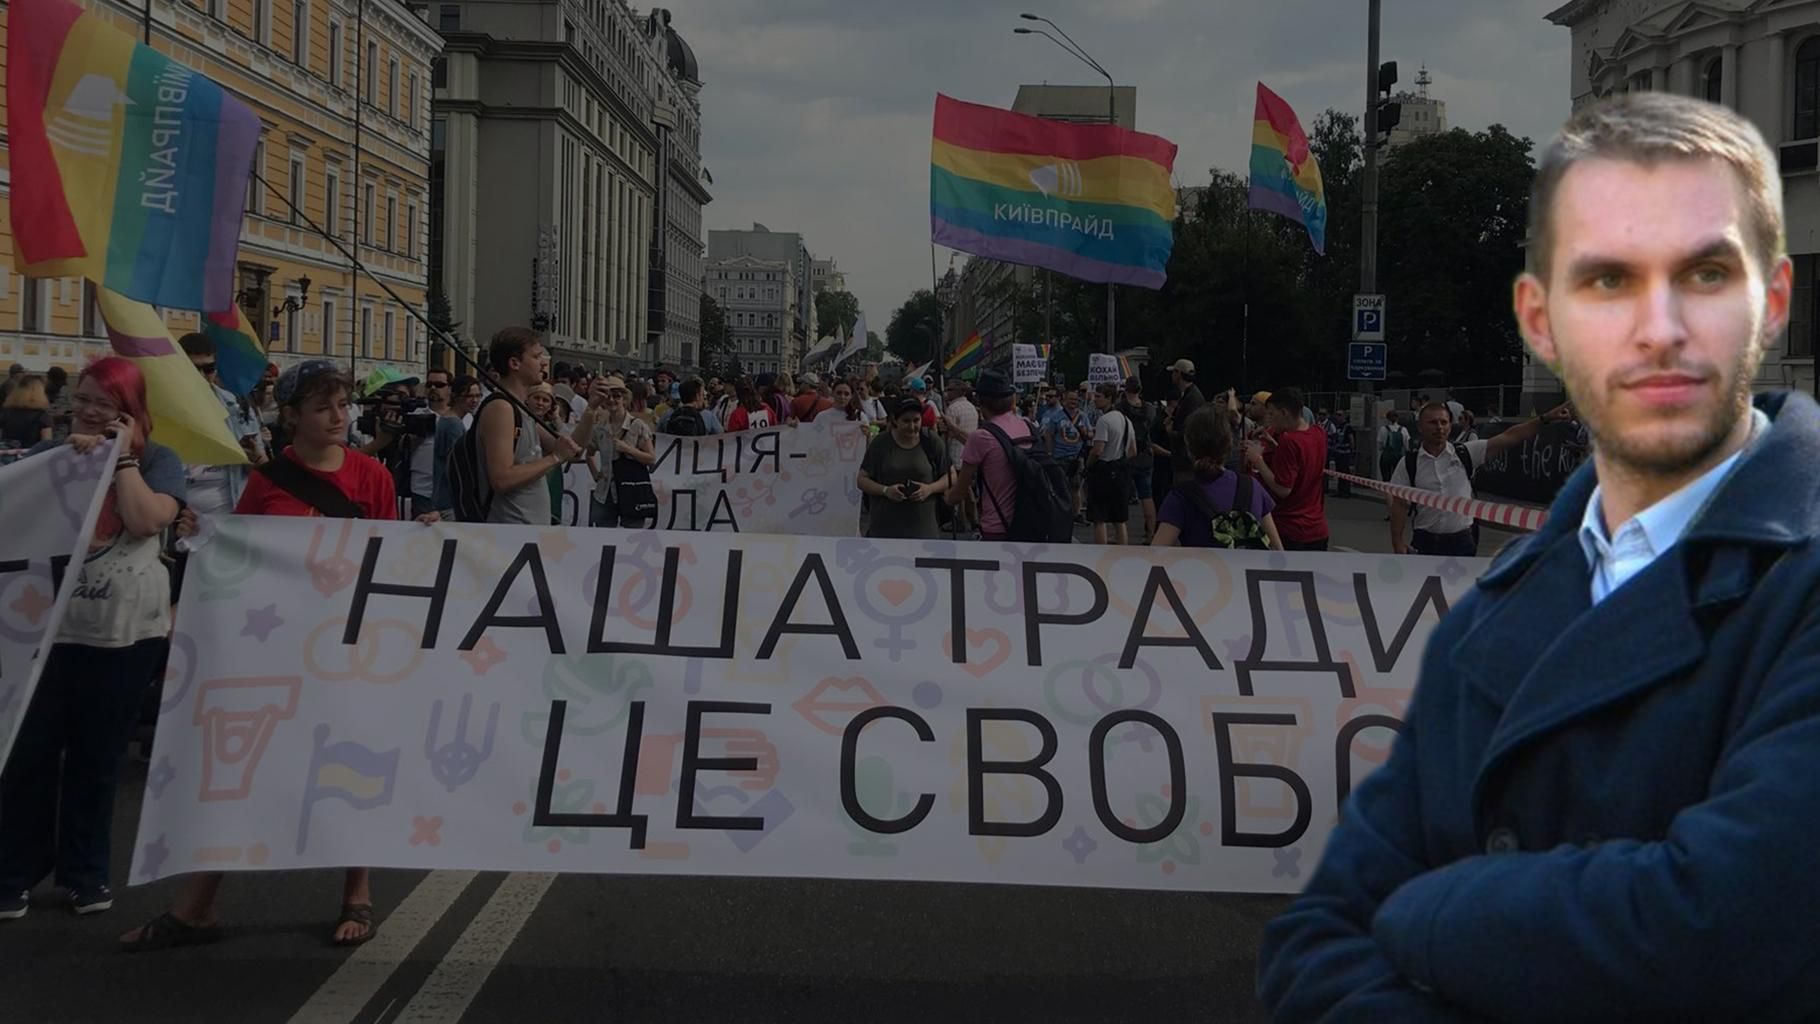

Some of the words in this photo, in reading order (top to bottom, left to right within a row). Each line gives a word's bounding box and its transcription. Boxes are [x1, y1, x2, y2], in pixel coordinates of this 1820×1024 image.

[993, 203, 1115, 241] КИЇВПРАЙД
[1356, 297, 1382, 307] ЗОНА
[1363, 311, 1377, 331] P
[1363, 345, 1374, 358] P
[1520, 433, 1554, 480] the
[70, 578, 113, 601] aid
[342, 536, 862, 660] НАША
[915, 557, 1452, 698] ТРАДИ
[532, 699, 772, 849] ЦЕ
